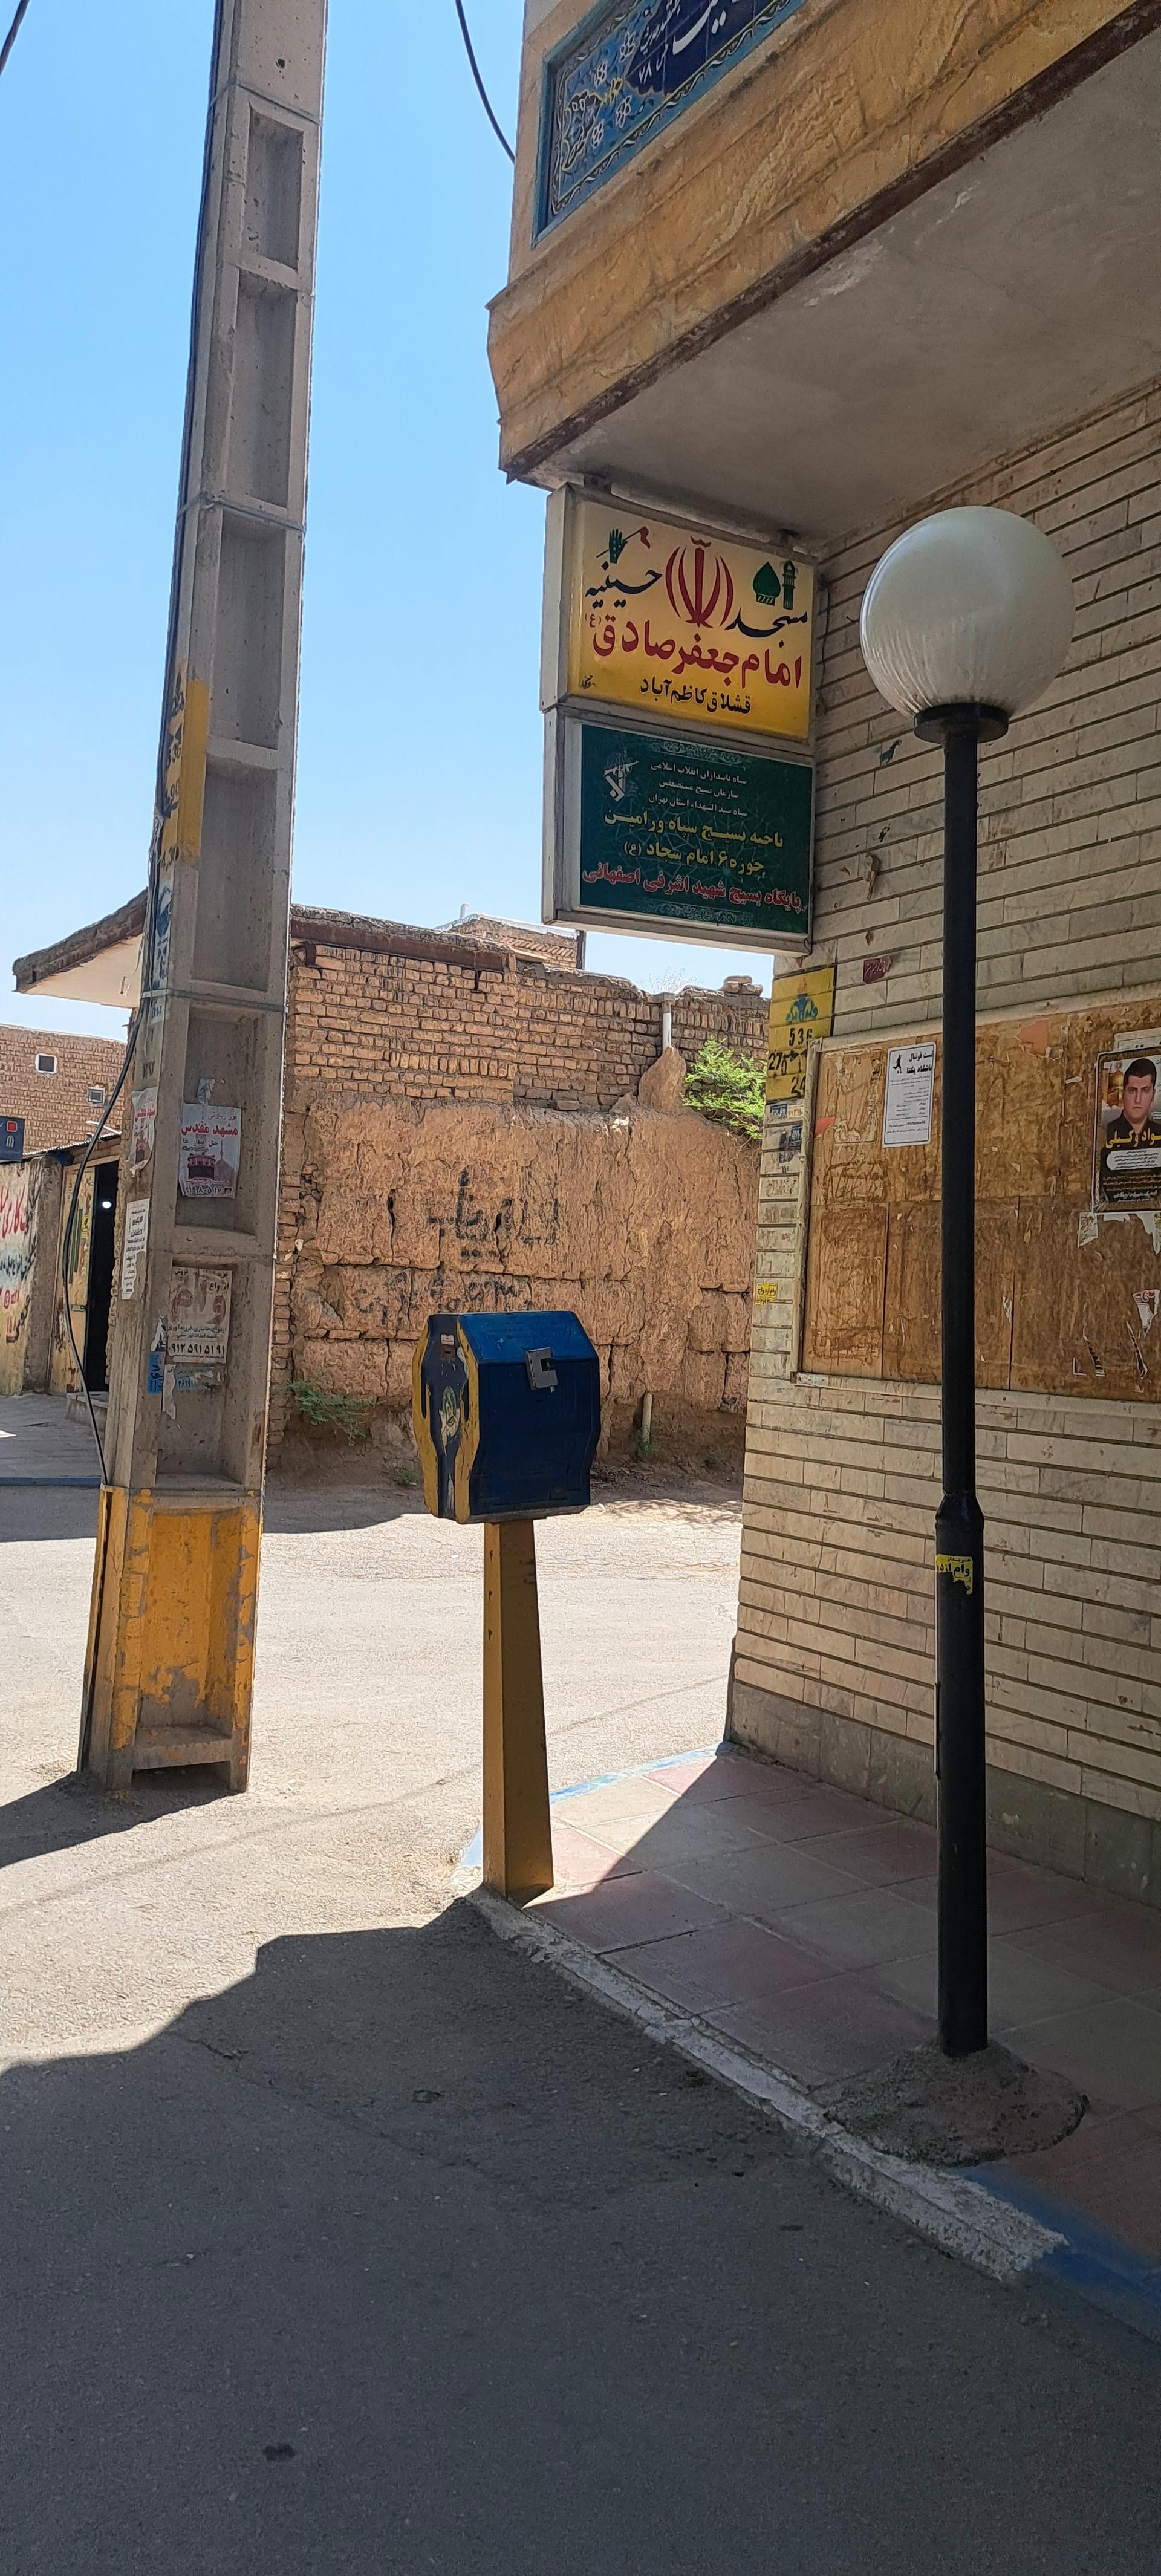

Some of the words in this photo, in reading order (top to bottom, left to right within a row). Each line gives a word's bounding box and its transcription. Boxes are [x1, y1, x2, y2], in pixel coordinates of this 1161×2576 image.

[584, 562, 663, 609] حسینیه
[592, 613, 677, 660] صادق
[724, 607, 808, 649] مسجد
[671, 632, 740, 687] جعفر
[741, 648, 802, 689] امام
[705, 691, 751, 715] قشلاق
[650, 761, 676, 772] اسلامی
[604, 809, 665, 834] ورامین
[668, 816, 698, 839] سپاه
[701, 824, 747, 844] بسیج
[749, 831, 784, 848] ناحیه
[646, 841, 681, 862] سجاد
[686, 849, 714, 867] امام
[582, 860, 641, 885] اصفهانی
[643, 869, 690, 895] اشرفی
[691, 880, 727, 900] شهید
[728, 886, 762, 907] بسیج
[764, 888, 802, 911] پایگاه
[789, 1027, 813, 1047] 536
[908, 1051, 923, 1062] فوتبال
[181, 1120, 210, 1136] مقدس
[213, 1123, 238, 1137] مشهد
[953, 1563, 970, 1577] وام
